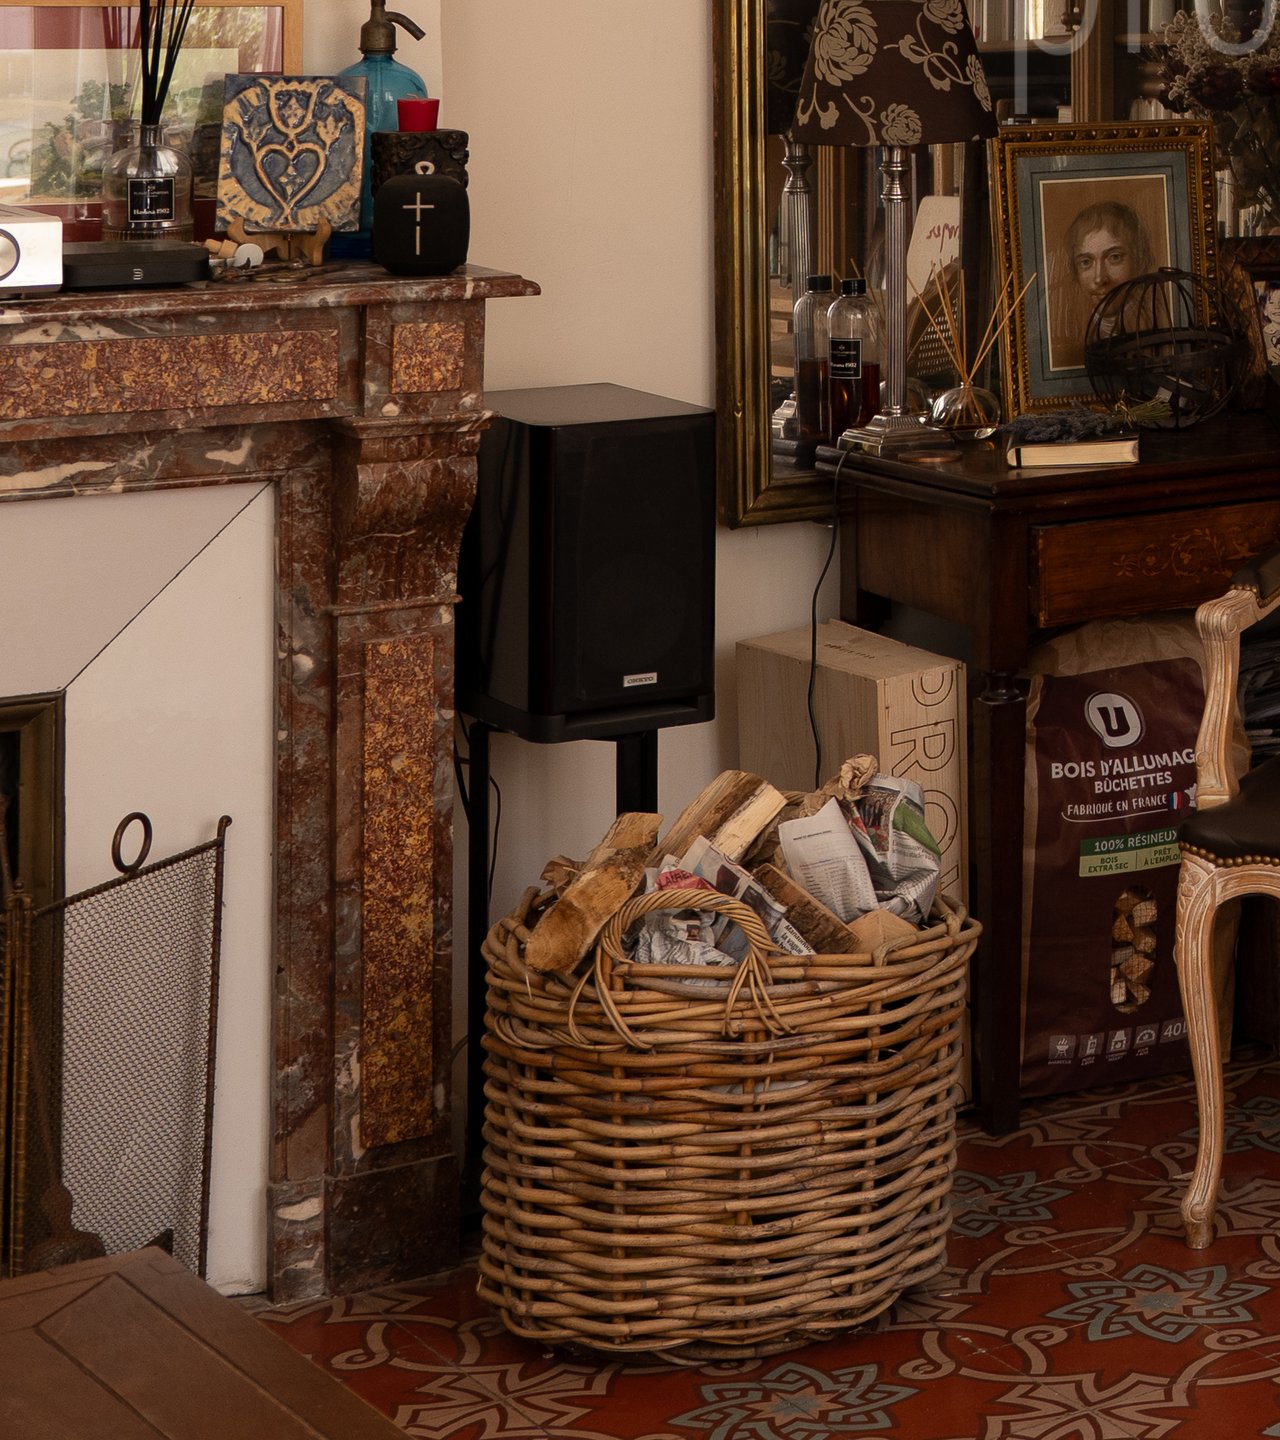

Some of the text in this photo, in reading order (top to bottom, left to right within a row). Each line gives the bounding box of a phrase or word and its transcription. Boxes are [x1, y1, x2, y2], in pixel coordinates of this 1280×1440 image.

[1097, 706, 1130, 737] U
[1051, 748, 1196, 779] BOIS D'ALLUMAG
[1094, 771, 1173, 794] BÛCHETTES
[1067, 794, 1167, 816] FABRIQUÉ EN FRANCE
[1094, 839, 1124, 852] 100%
[1154, 847, 1171, 856] PRÊT
[1100, 856, 1118, 864] BOIS
[1143, 858, 1149, 866] À
[1088, 863, 1114, 873] EXTRA
